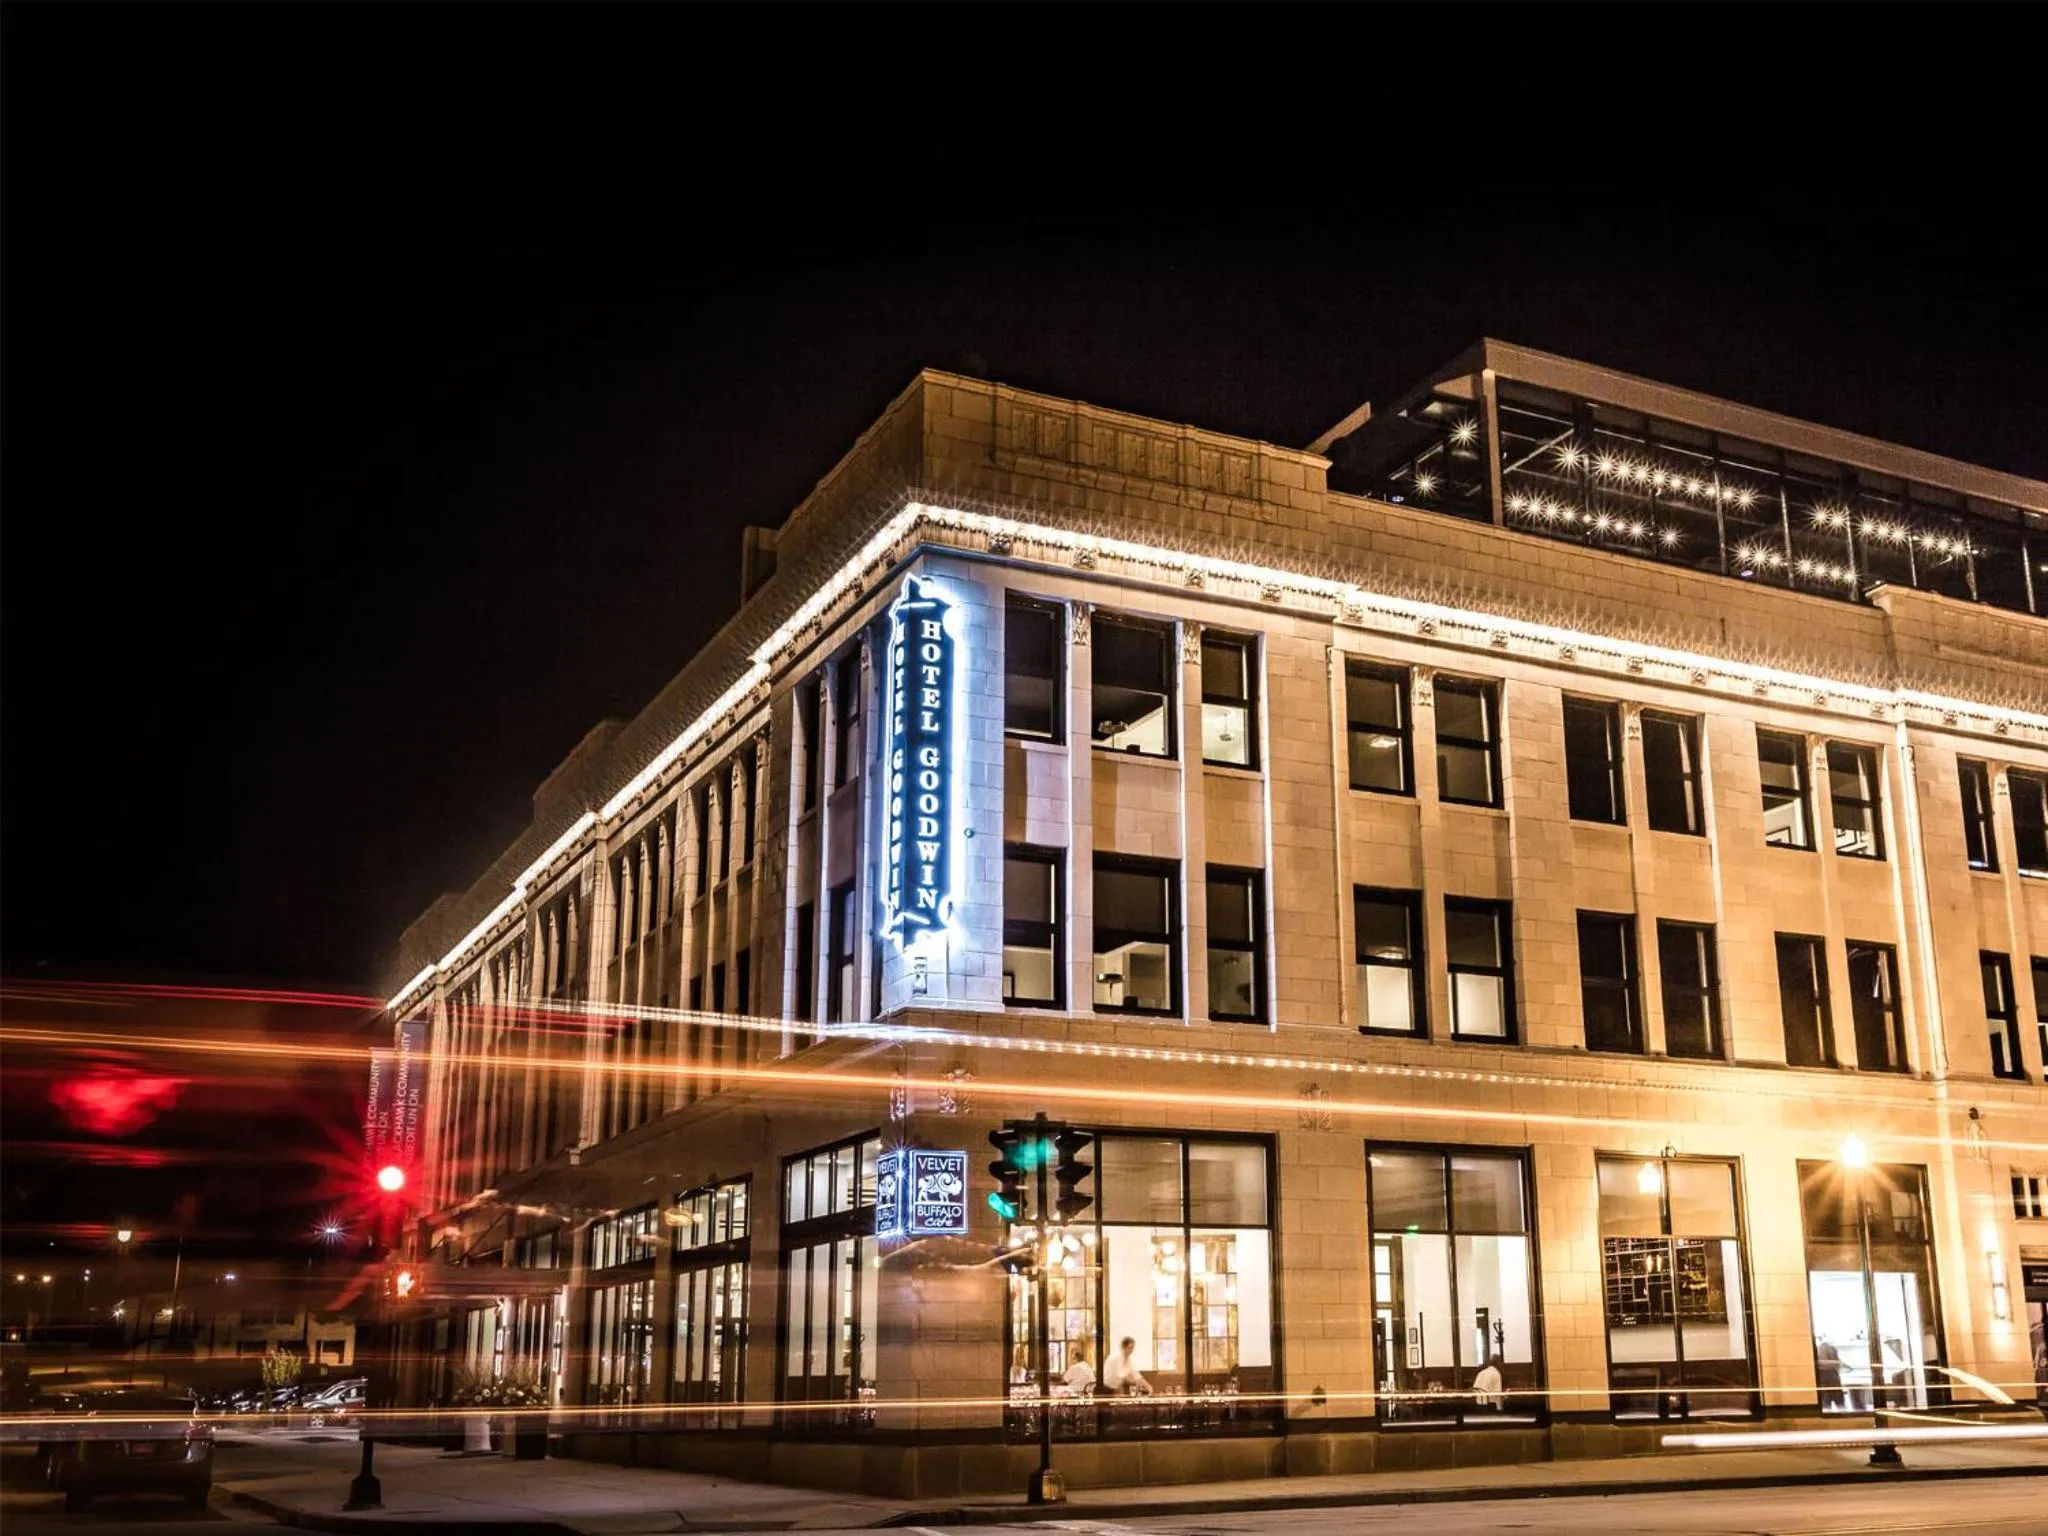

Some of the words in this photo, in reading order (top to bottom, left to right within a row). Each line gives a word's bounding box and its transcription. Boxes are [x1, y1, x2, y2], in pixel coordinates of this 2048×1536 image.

[920, 619, 942, 733] HOTEL
[916, 746, 942, 909] GOODWIN
[367, 1059, 381, 1120] COMMUNITY
[396, 1032, 412, 1097] COMMUNITY
[918, 1157, 961, 1171] VELVET
[917, 1206, 962, 1217] BUFFALO
